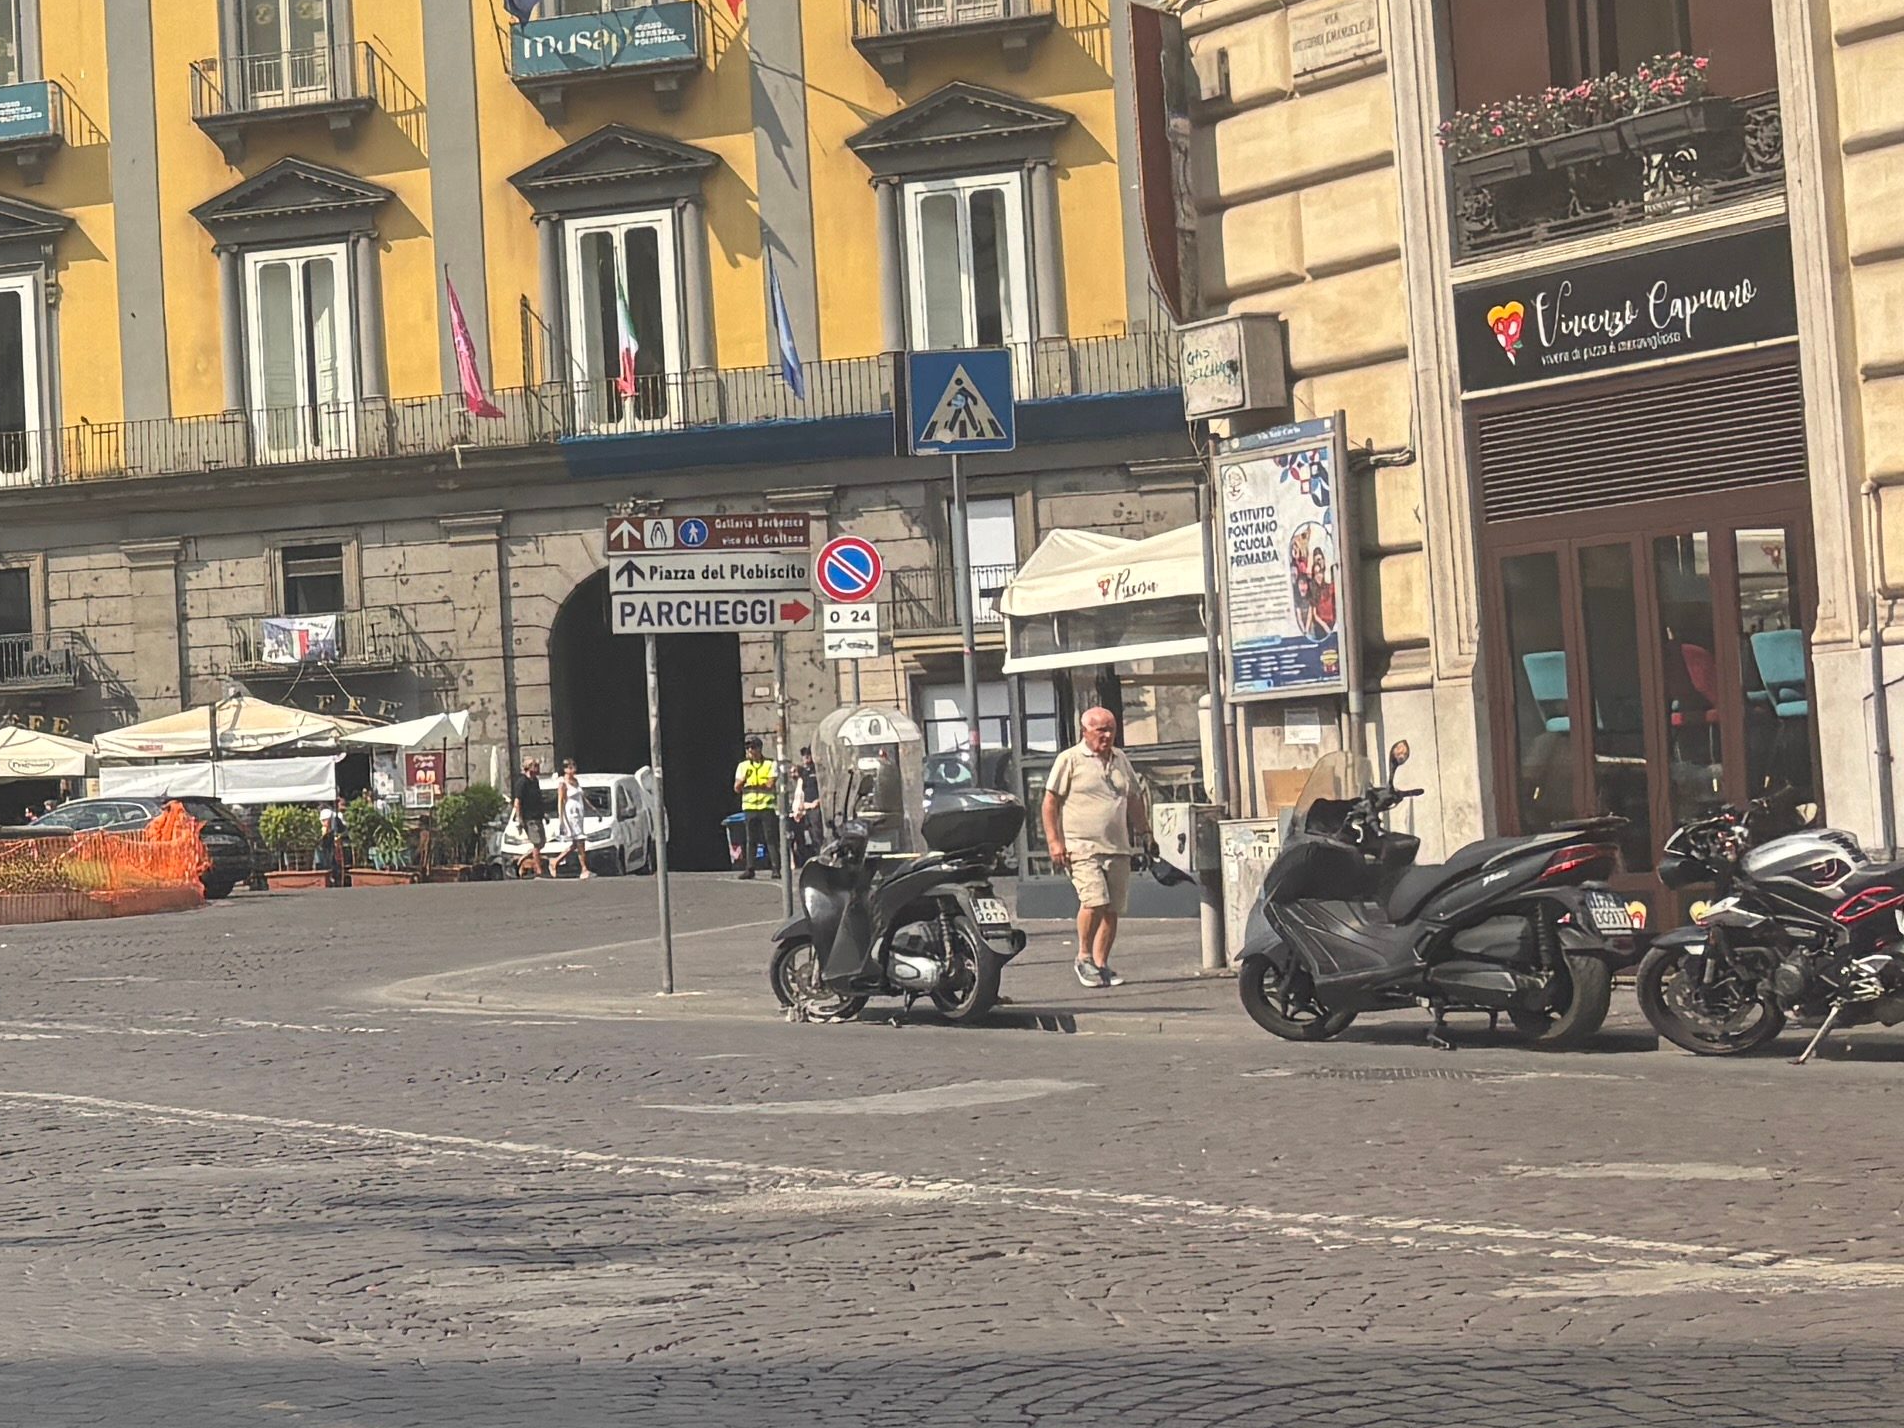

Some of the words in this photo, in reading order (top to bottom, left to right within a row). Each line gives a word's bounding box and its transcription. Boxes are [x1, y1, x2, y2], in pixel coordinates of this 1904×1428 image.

[1532, 280, 1639, 347] Vincenzo
[1646, 278, 1757, 339] Capuano
[1230, 505, 1275, 523] ISTITUTO
[1228, 520, 1278, 539] PONTANO
[744, 534, 759, 544] del
[1233, 535, 1274, 553] SCUOLA
[1230, 549, 1279, 567] PRIMARIA
[649, 565, 696, 582] Piazza
[702, 563, 725, 581] del
[730, 561, 806, 580] Plebiscito
[619, 598, 775, 627] PARCHEGGI
[850, 610, 871, 622] 24
